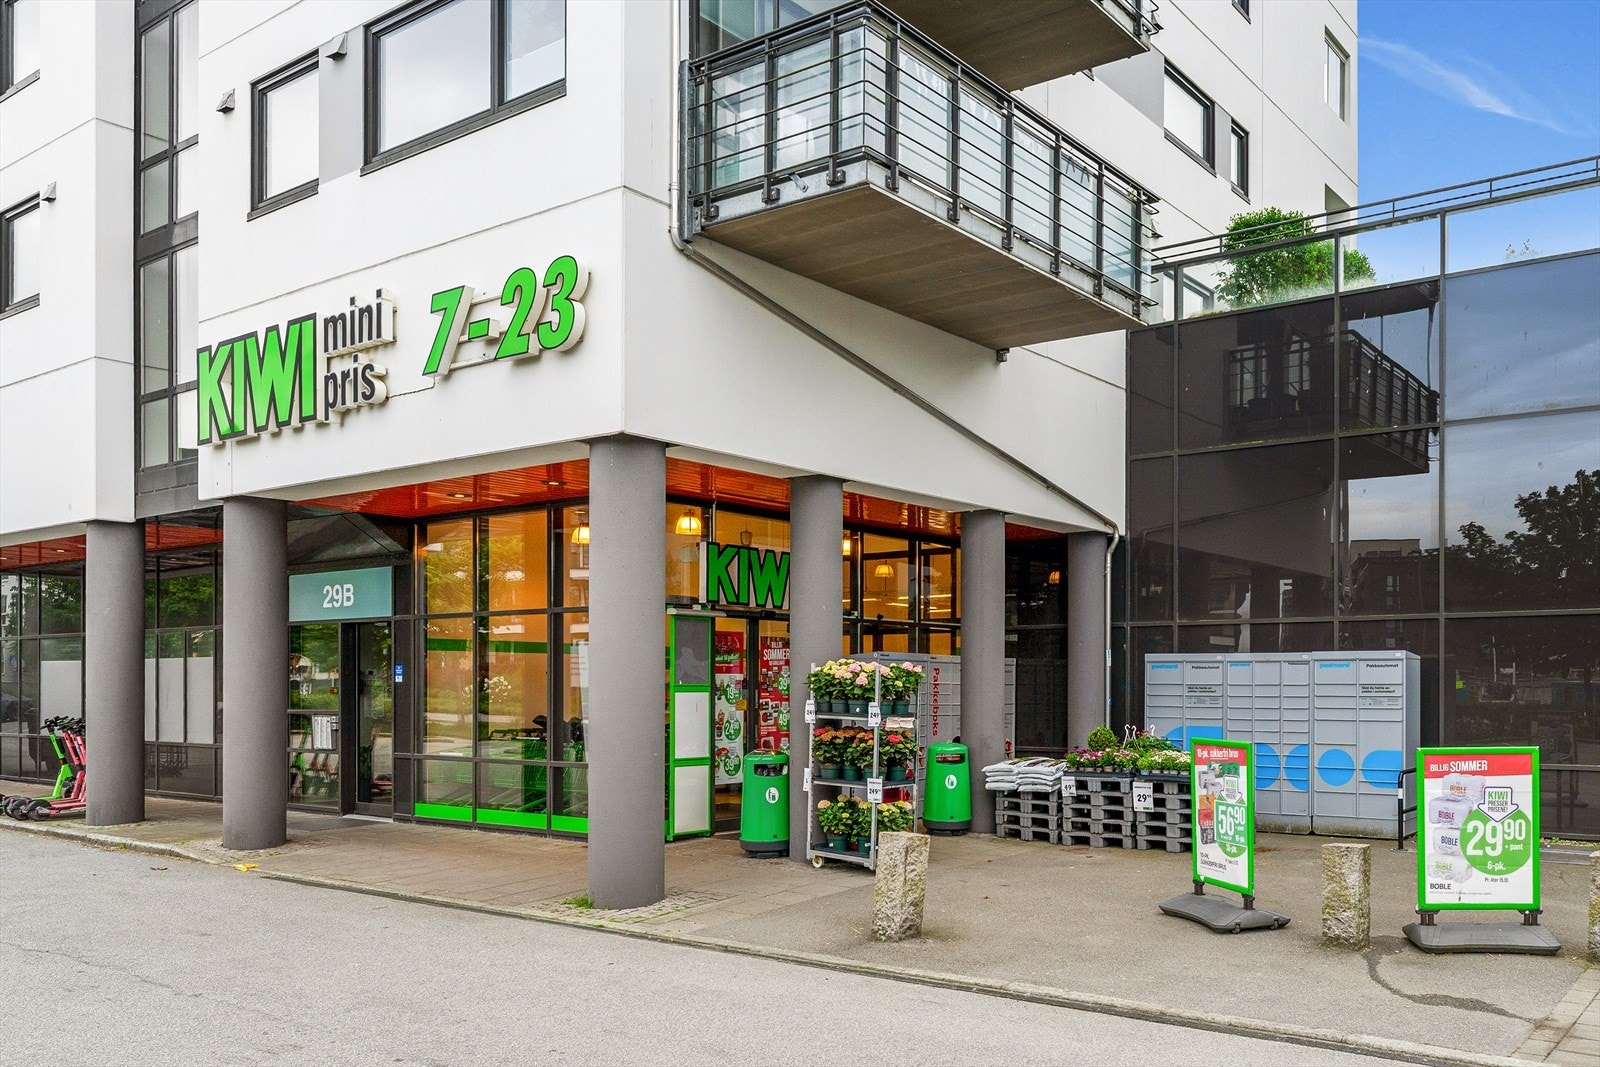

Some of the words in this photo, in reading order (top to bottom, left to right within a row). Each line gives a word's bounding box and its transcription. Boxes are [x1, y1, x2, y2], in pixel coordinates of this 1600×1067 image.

[323, 288, 384, 353] mini
[422, 254, 580, 377] 7-23
[196, 313, 317, 446] KIWI
[323, 354, 377, 421] pris
[707, 542, 790, 609] KIW
[323, 584, 355, 608] 29B
[932, 668, 940, 736] Pakkeboks
[1430, 763, 1449, 772] BILLIG
[1450, 760, 1488, 772] SOMMER
[1488, 791, 1508, 800] KIWI
[1438, 810, 1455, 820] BOBLE
[1441, 836, 1458, 846] BOBLE
[1509, 843, 1524, 851] pant
[1487, 860, 1506, 871] 6-pk.
